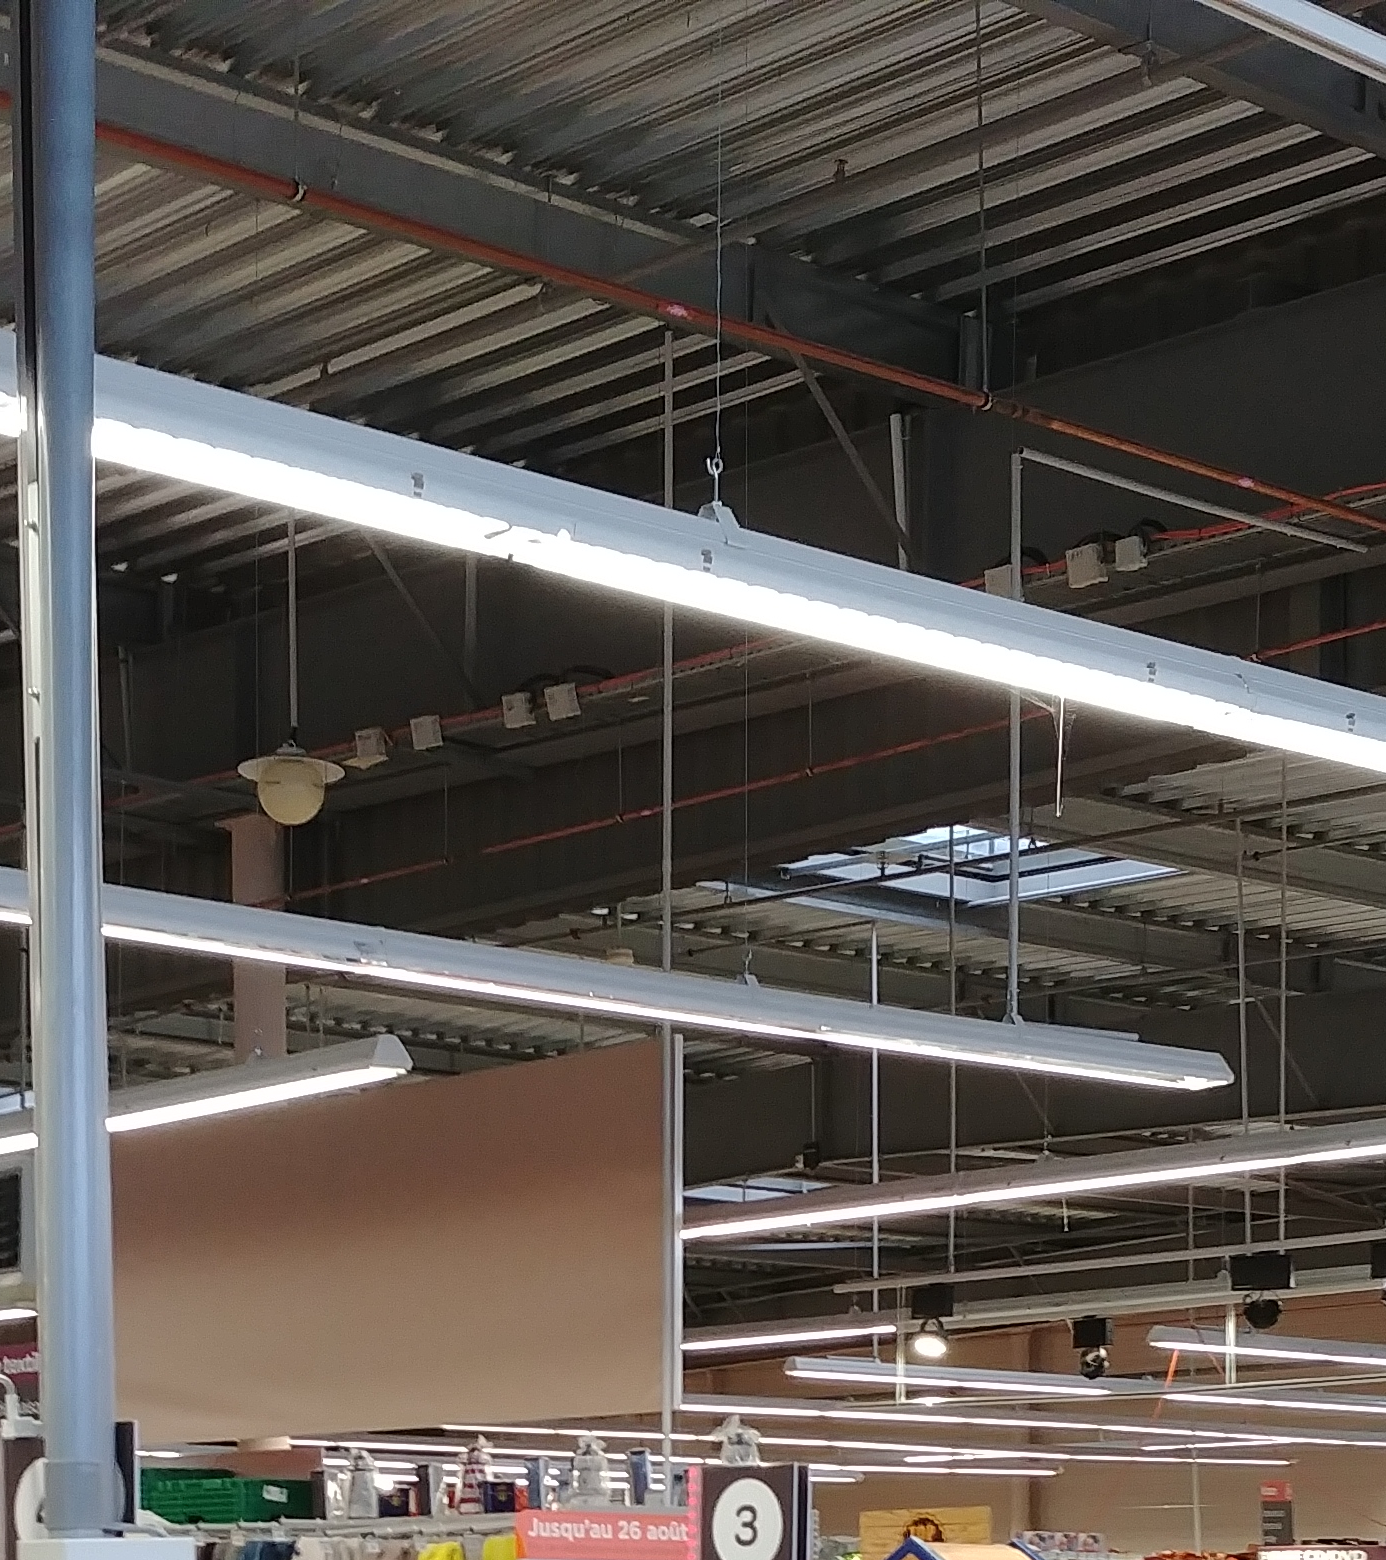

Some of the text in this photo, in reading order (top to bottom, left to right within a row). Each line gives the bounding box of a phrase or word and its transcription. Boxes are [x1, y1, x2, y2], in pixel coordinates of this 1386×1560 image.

[527, 1517, 690, 1542] Jusqu'au 26 août
[734, 1504, 758, 1546] 3
